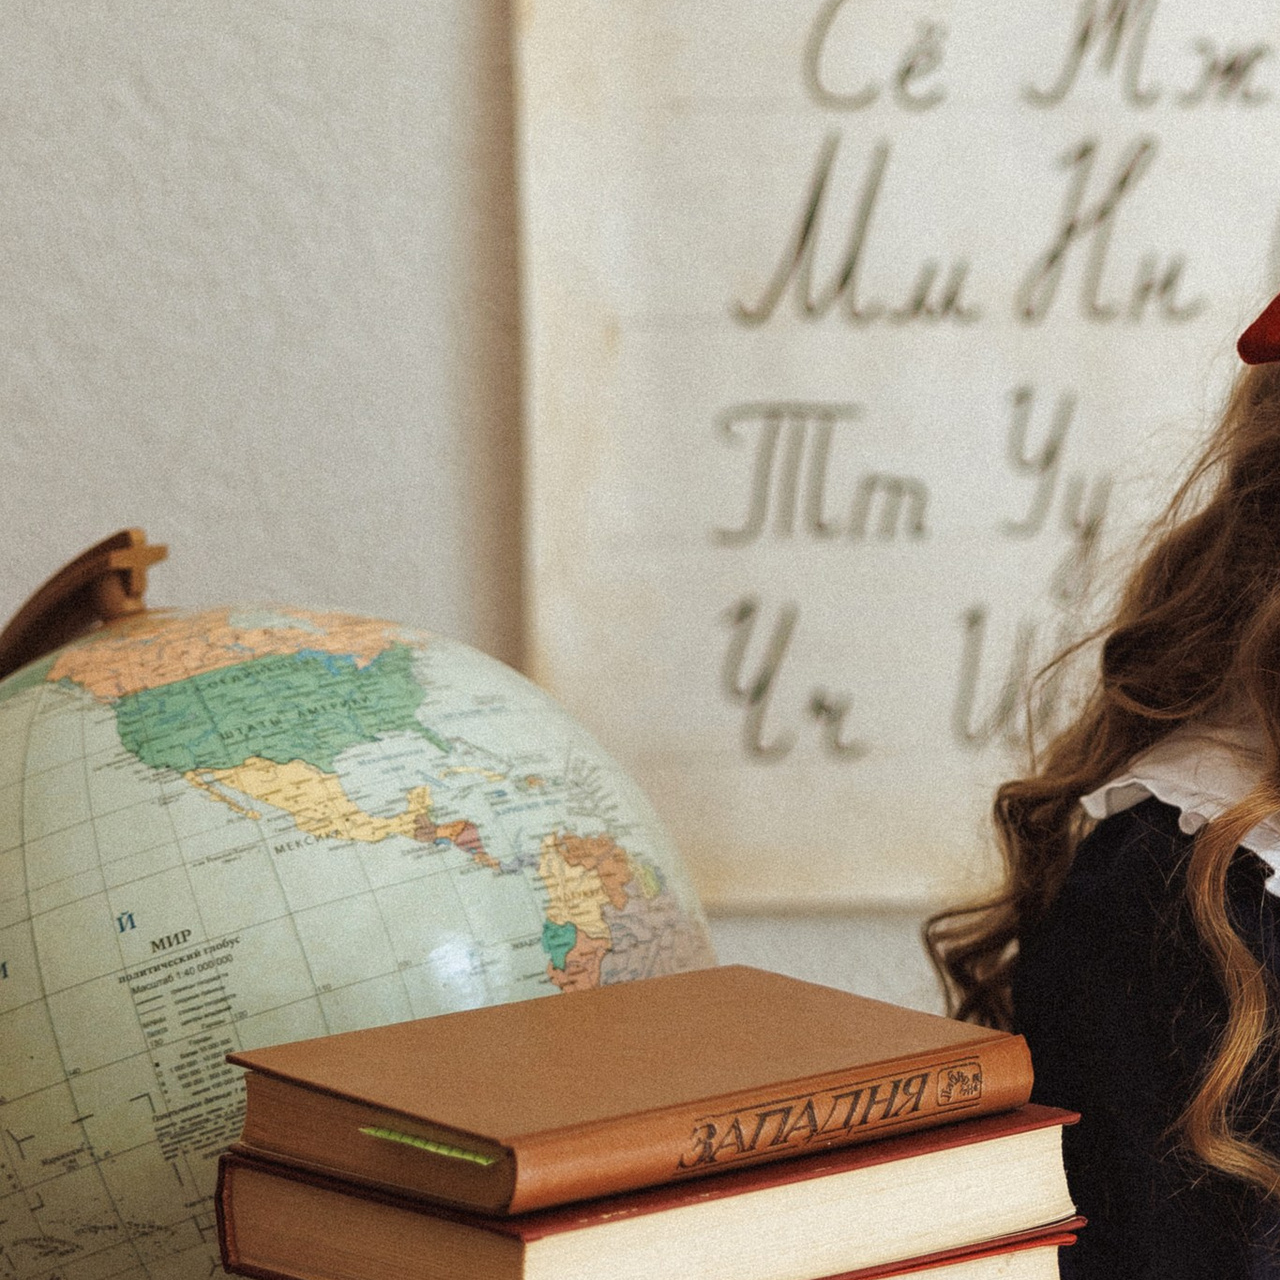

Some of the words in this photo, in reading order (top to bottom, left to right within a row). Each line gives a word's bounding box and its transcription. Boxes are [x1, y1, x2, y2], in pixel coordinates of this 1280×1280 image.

[727, 129, 983, 327] Мм
[1014, 134, 1205, 324] Нн
[118, 949, 201, 985] политический
[203, 935, 241, 956] глобус
[150, 928, 193, 954] МИР
[131, 974, 175, 995] Масштаб
[678, 1071, 932, 1170] ЗАПАДНЯ
